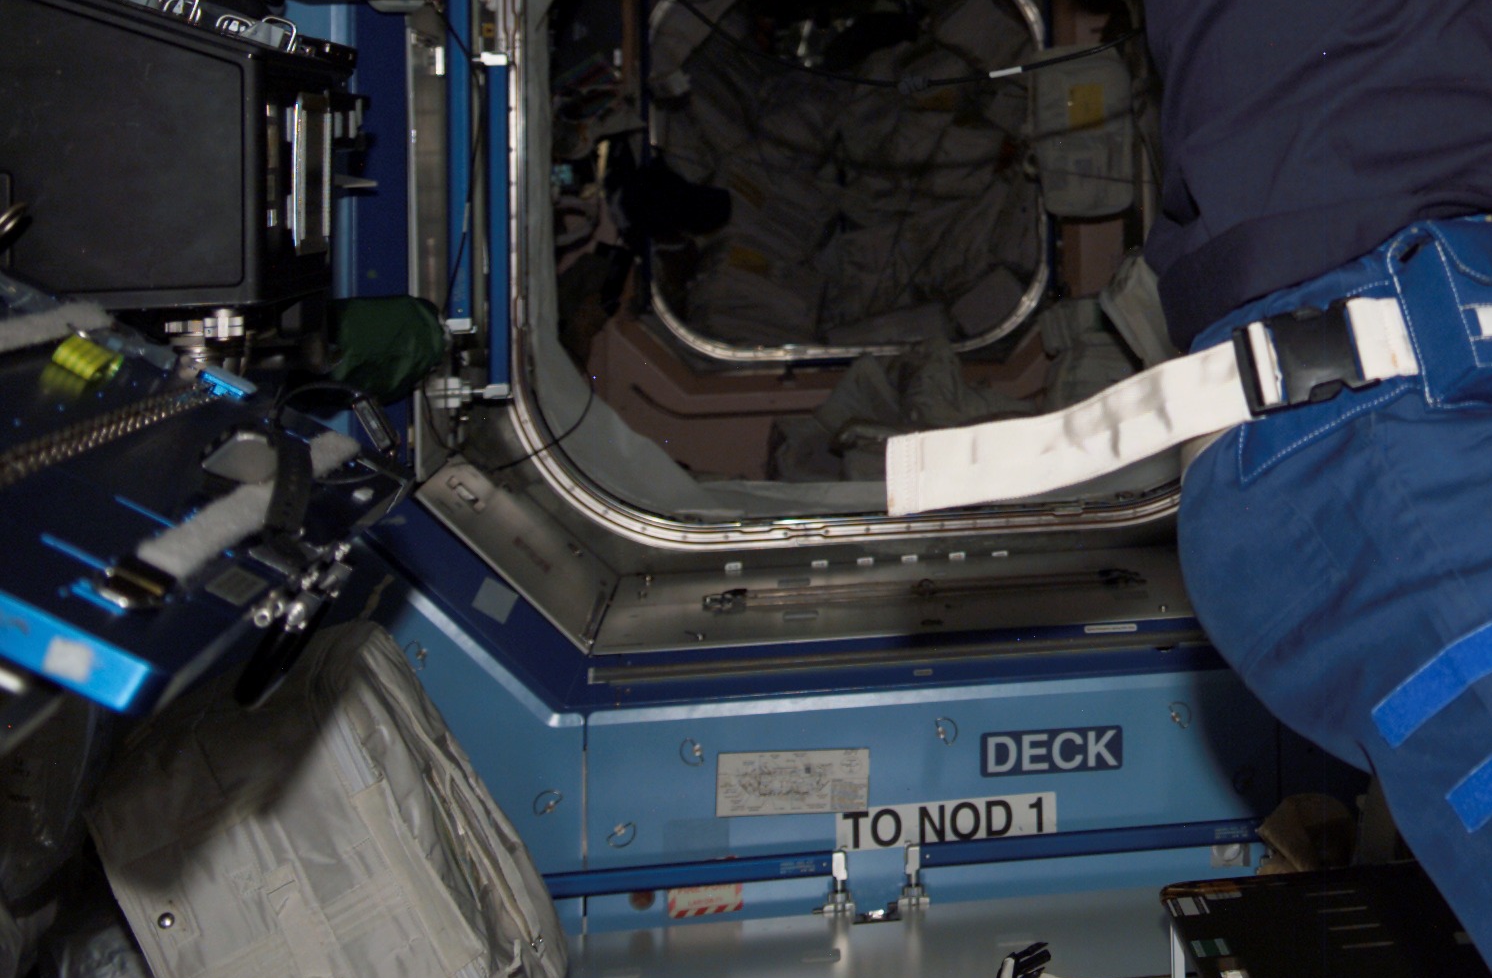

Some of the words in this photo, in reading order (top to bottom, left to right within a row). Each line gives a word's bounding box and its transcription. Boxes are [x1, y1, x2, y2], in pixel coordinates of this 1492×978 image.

[986, 728, 1121, 775] DECK
[843, 808, 902, 850] TO
[919, 799, 1013, 844] NOD
[1028, 798, 1045, 833] 1
